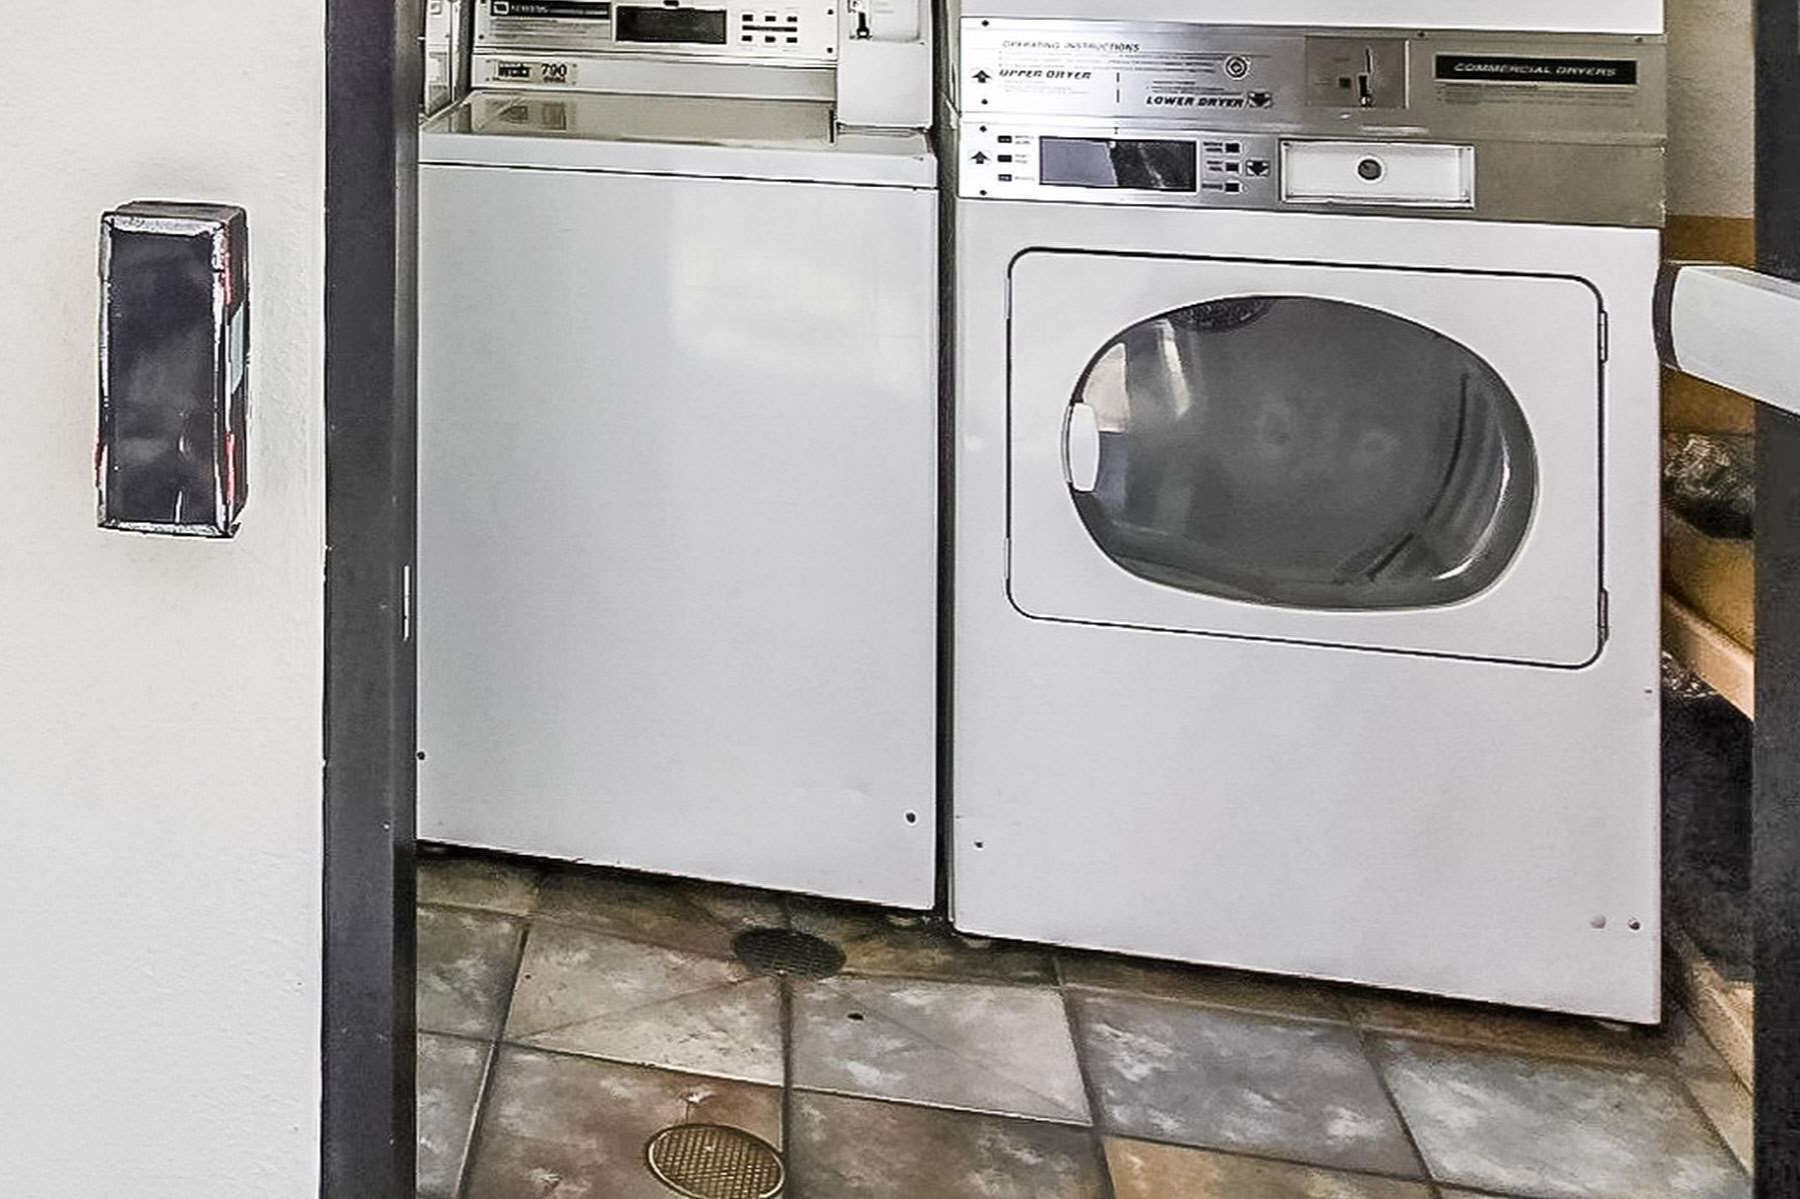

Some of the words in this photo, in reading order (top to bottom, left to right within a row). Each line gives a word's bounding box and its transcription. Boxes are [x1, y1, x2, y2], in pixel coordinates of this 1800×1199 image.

[1002, 39, 1061, 50] OPERATING
[1063, 41, 1141, 52] INSTRUCTIONS
[540, 63, 568, 77] 790
[999, 68, 1043, 78] UPPER
[1046, 69, 1092, 80] DRYER
[1454, 62, 1552, 75] COMMERCIAL
[1555, 66, 1617, 77] DRYERS
[1146, 95, 1194, 107] LOWER
[1197, 96, 1245, 109] DRYER
